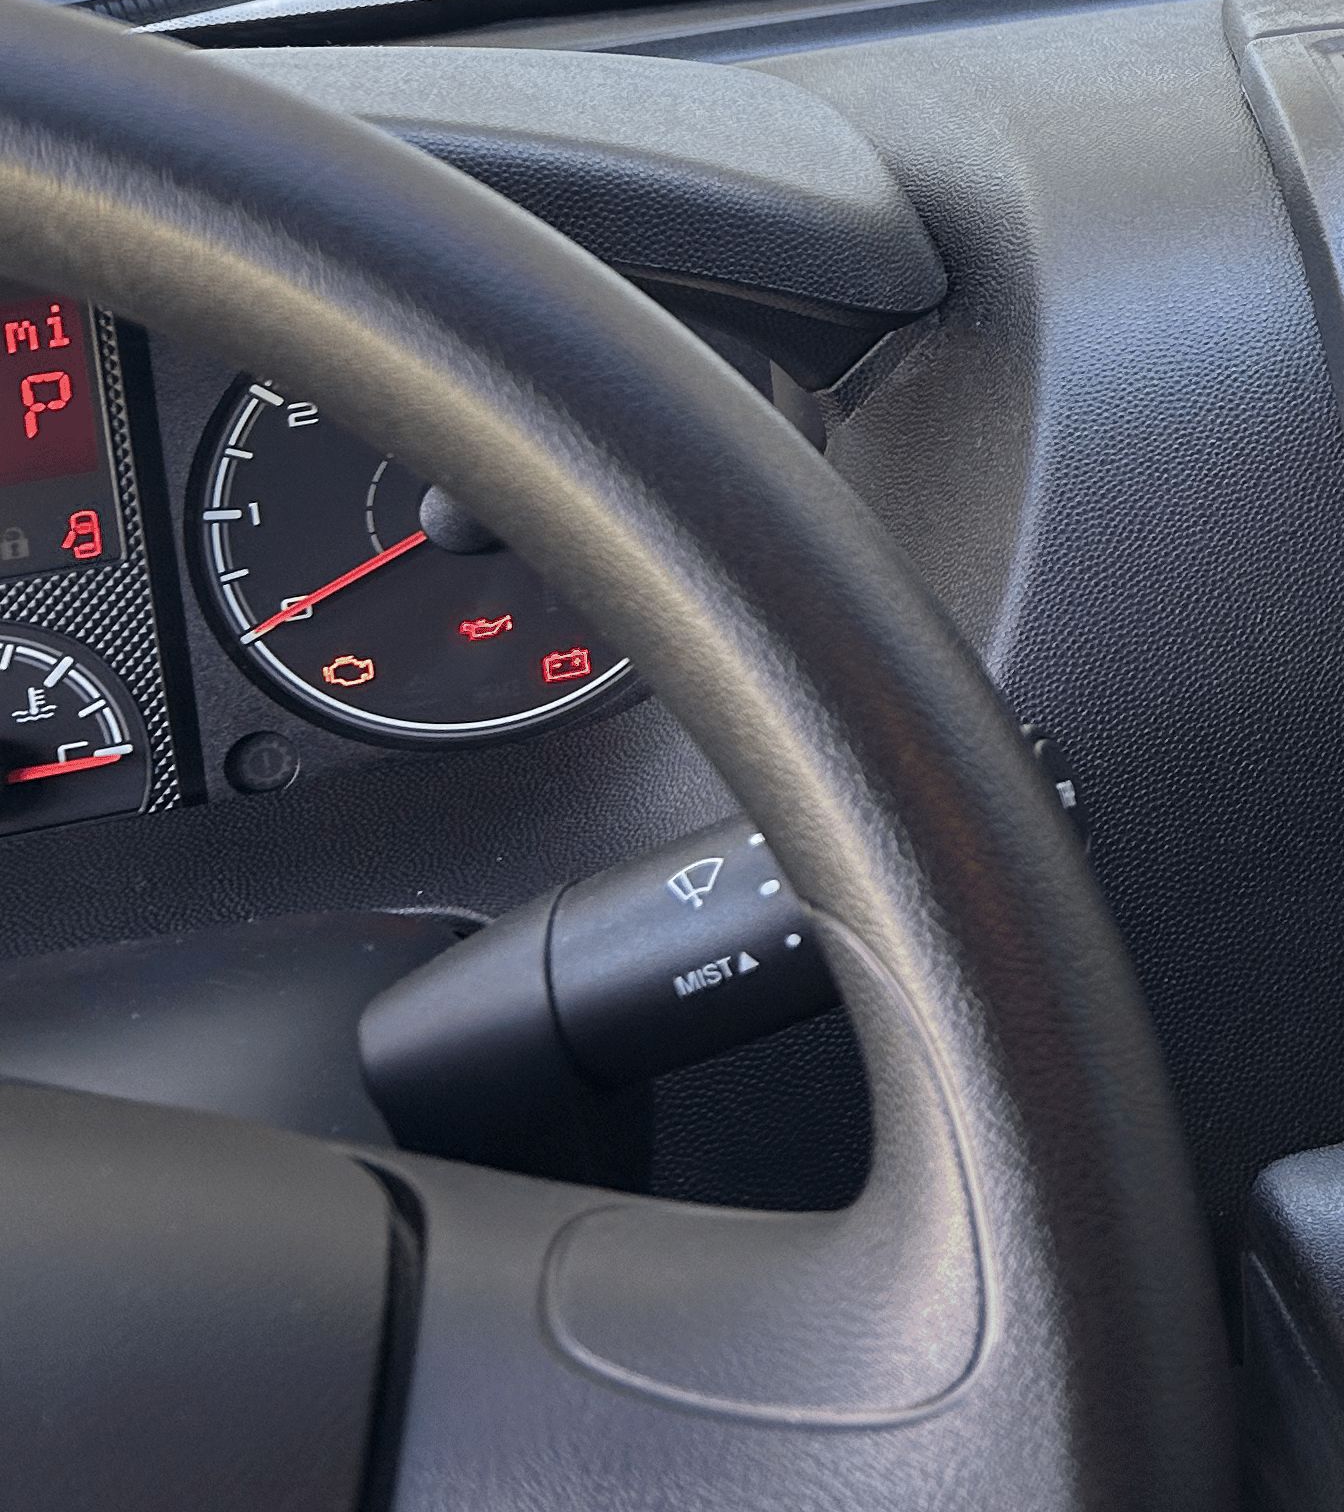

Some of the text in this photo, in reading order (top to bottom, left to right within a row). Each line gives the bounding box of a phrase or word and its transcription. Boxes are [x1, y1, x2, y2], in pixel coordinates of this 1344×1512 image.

[5, 304, 71, 354] mi
[21, 371, 72, 439] P
[287, 401, 320, 428] 2
[248, 502, 261, 526] 1
[672, 955, 733, 999] MIST
